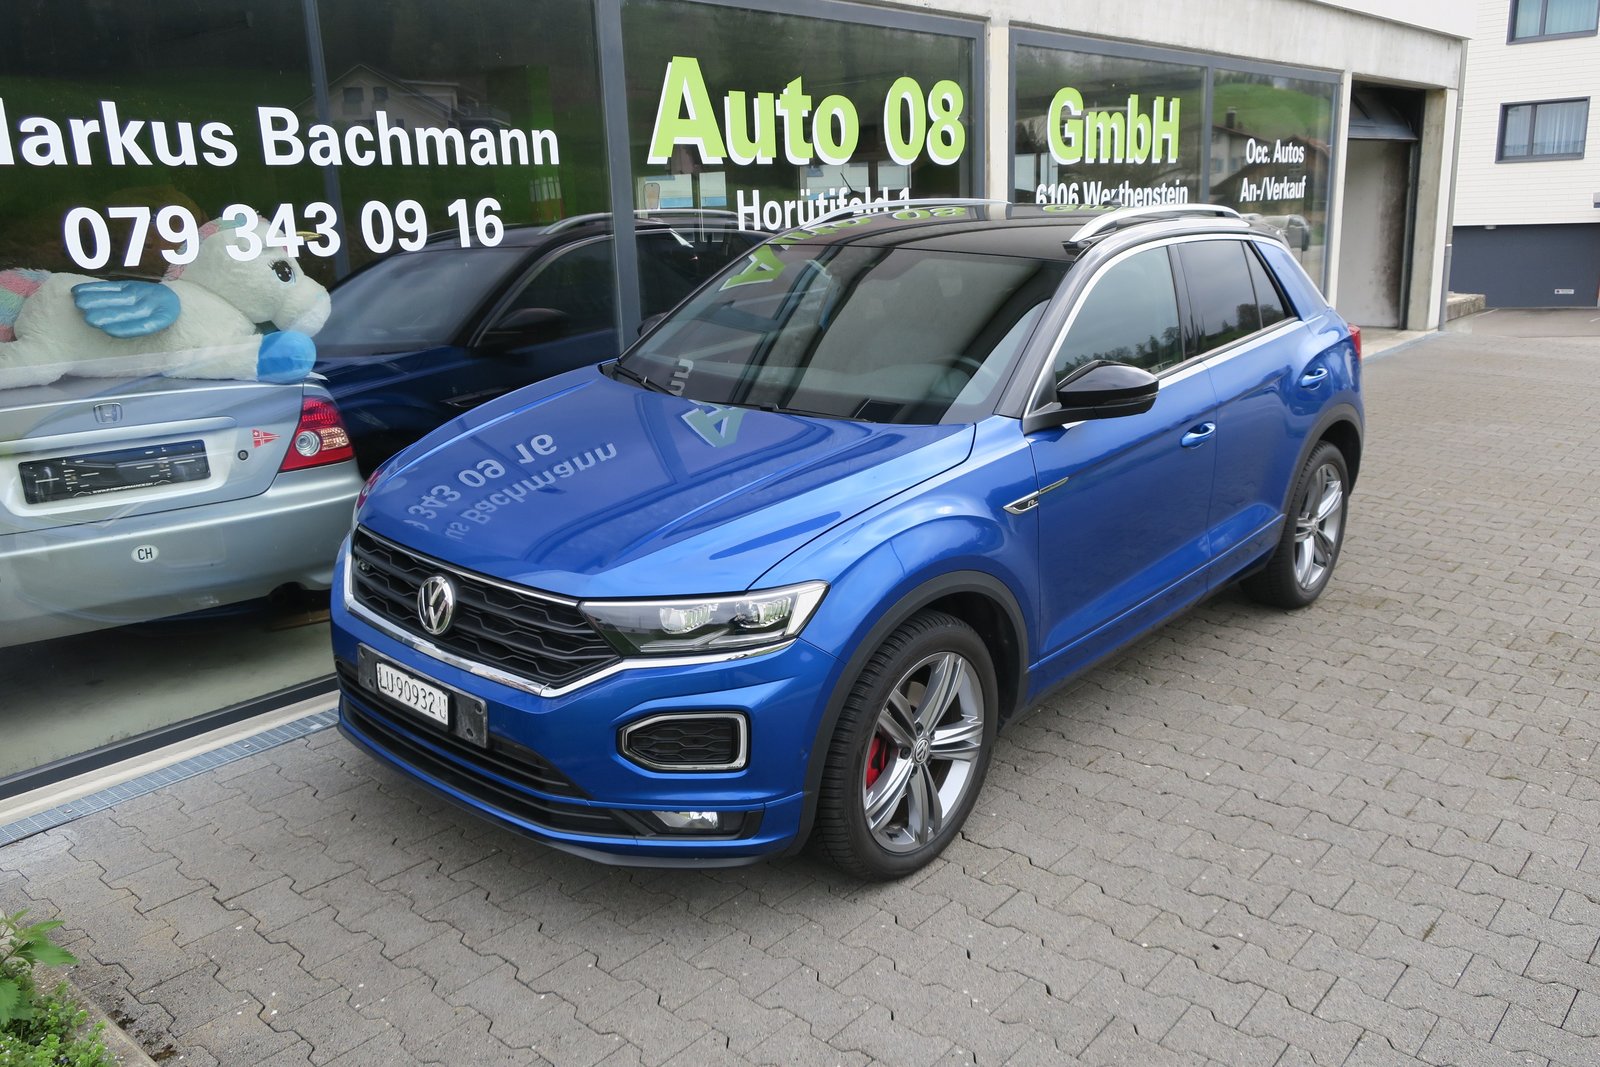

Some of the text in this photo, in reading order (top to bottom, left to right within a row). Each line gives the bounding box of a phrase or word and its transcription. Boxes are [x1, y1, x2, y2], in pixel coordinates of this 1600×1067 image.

[646, 56, 1181, 166] Auto 08 GmbH
[0, 97, 560, 167] arkus Bachmann
[1246, 139, 1305, 164] Occ. Autos
[1035, 182, 1079, 205] 6106
[1239, 175, 1306, 203] An-/Verkauf
[64, 198, 504, 270] 079 343 09 16
[137, 547, 153, 561] CH
